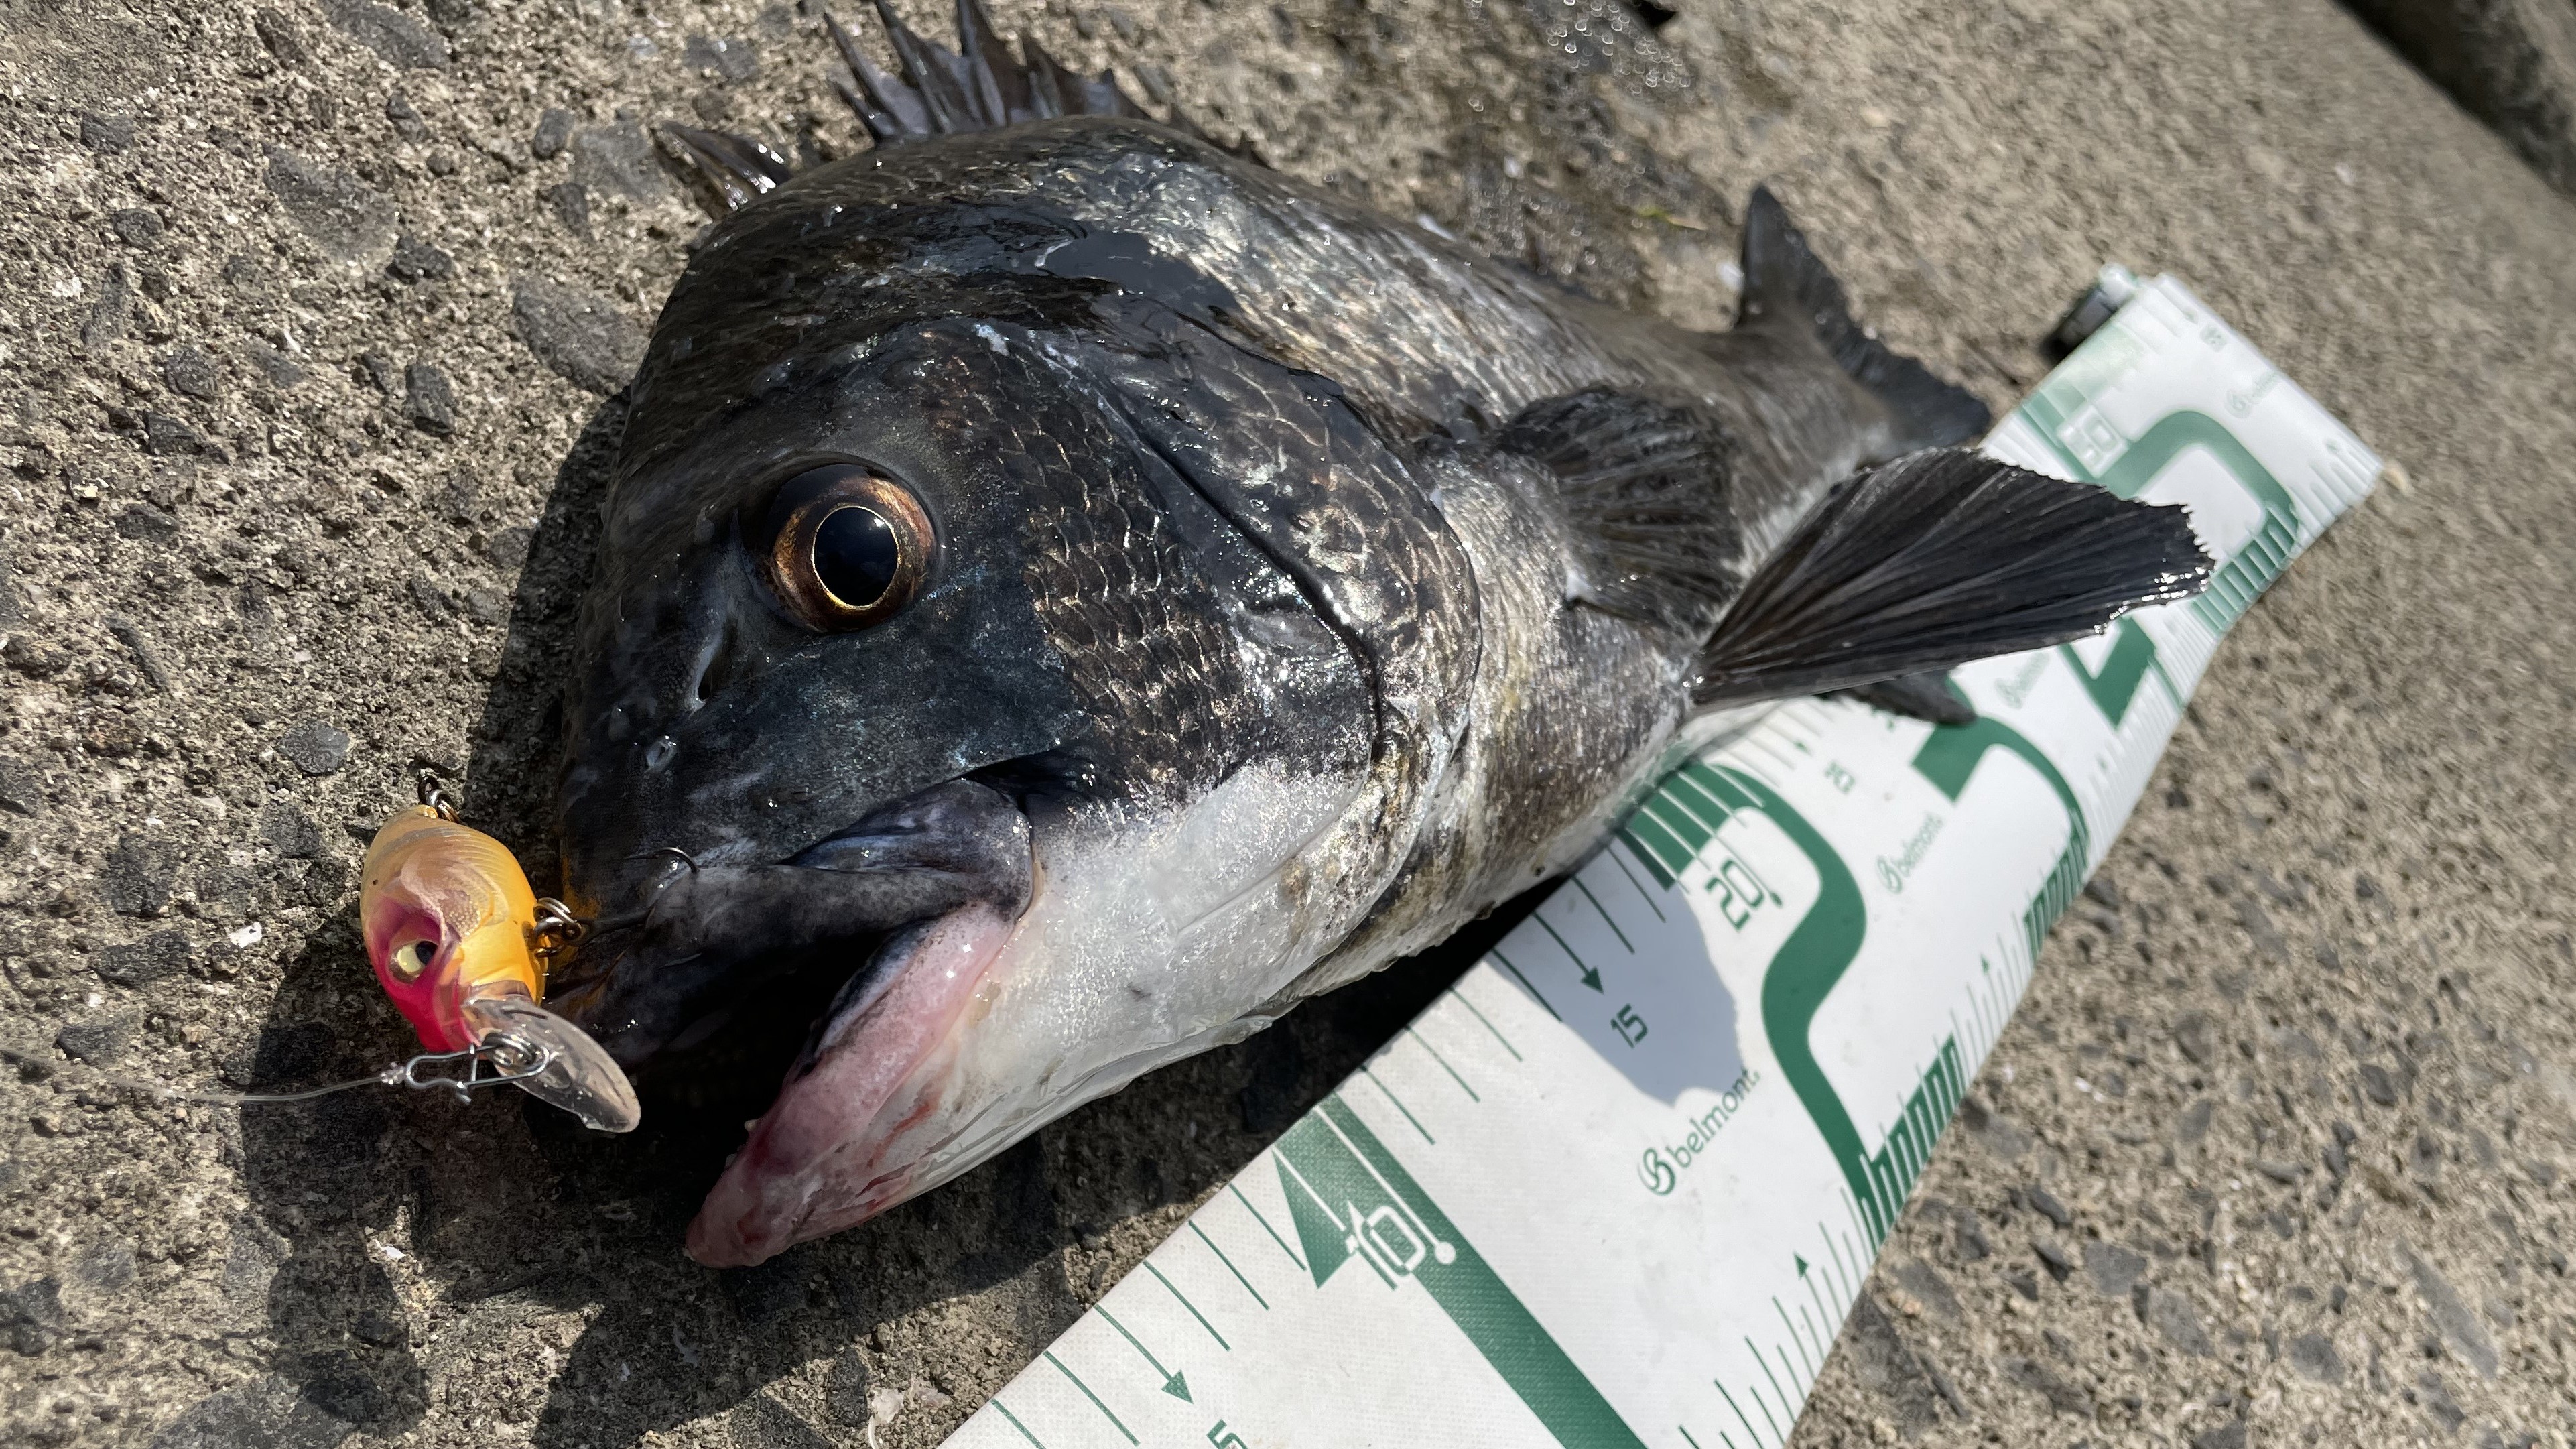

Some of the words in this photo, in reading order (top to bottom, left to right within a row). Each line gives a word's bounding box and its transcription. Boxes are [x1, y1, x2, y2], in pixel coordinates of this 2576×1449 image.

[1704, 859, 1764, 932] 20
[1610, 1003, 1648, 1049] 15
[1346, 1200, 1426, 1290] 10
[1206, 1418, 1248, 1449] 5
